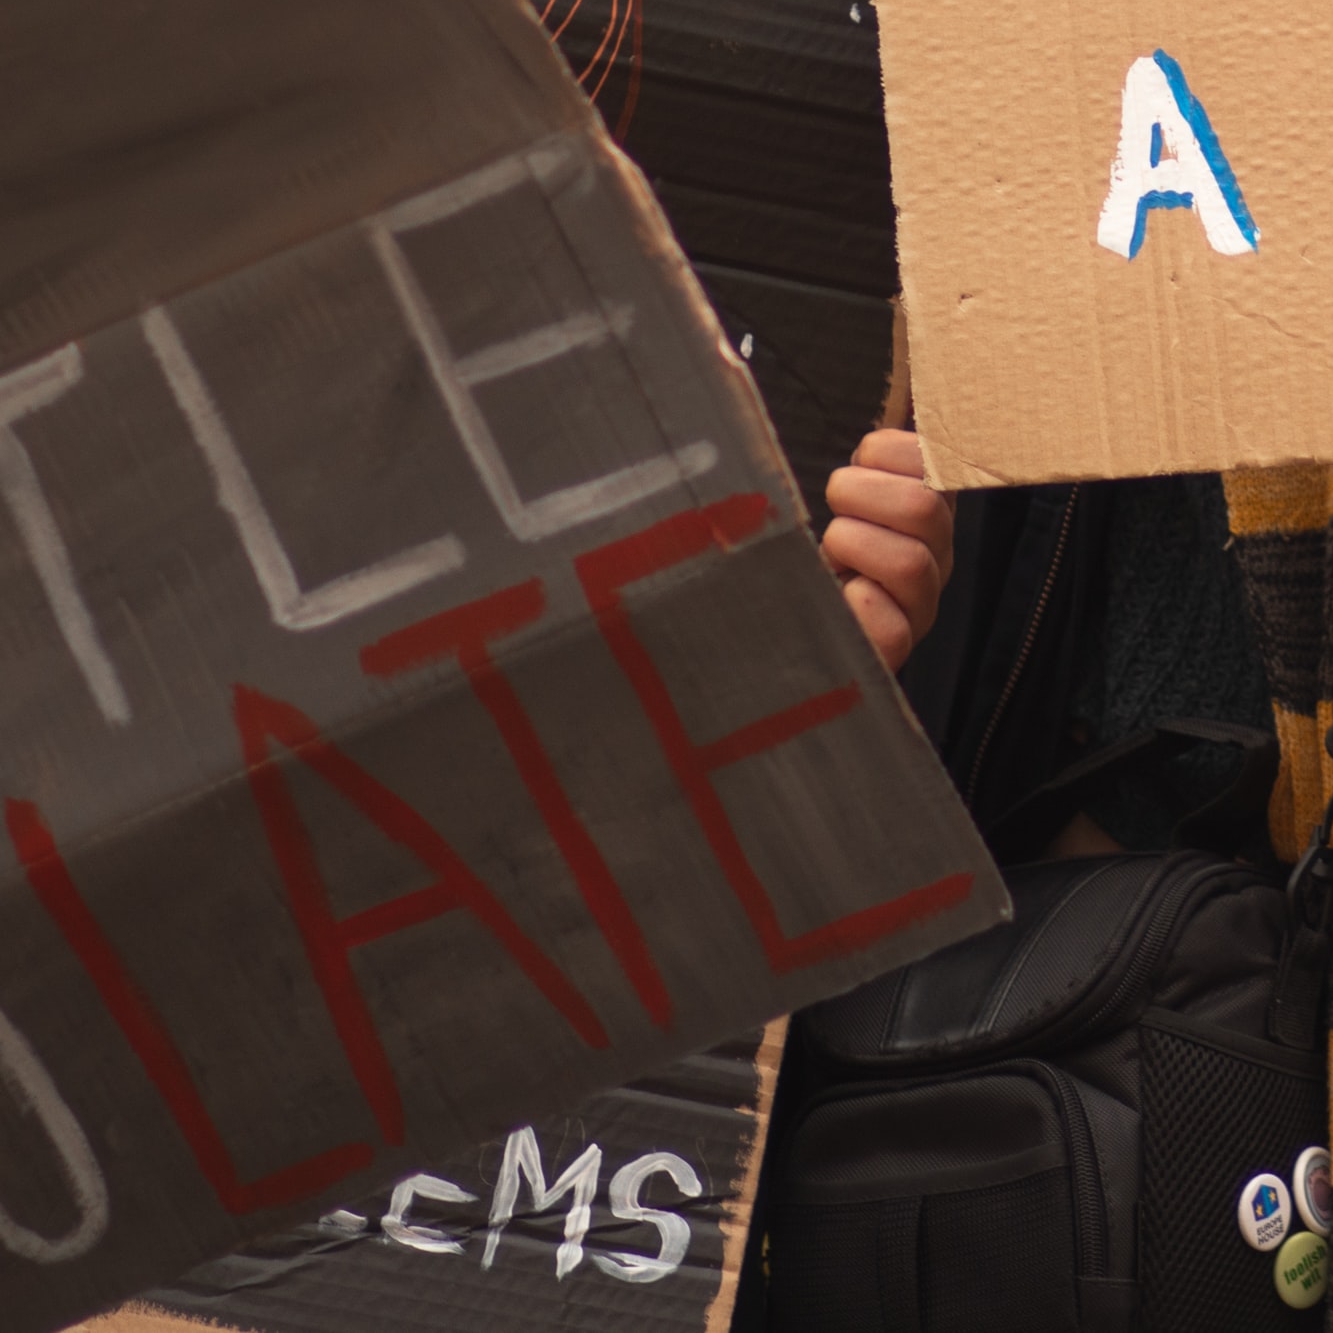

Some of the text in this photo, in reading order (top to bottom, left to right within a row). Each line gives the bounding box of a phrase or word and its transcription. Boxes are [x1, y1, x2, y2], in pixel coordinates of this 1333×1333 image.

[1097, 47, 1261, 261] A
[5, 492, 977, 1216] LATE
[1256, 1214, 1283, 1236] EUROPE
[1257, 1223, 1284, 1246] HOUSE
